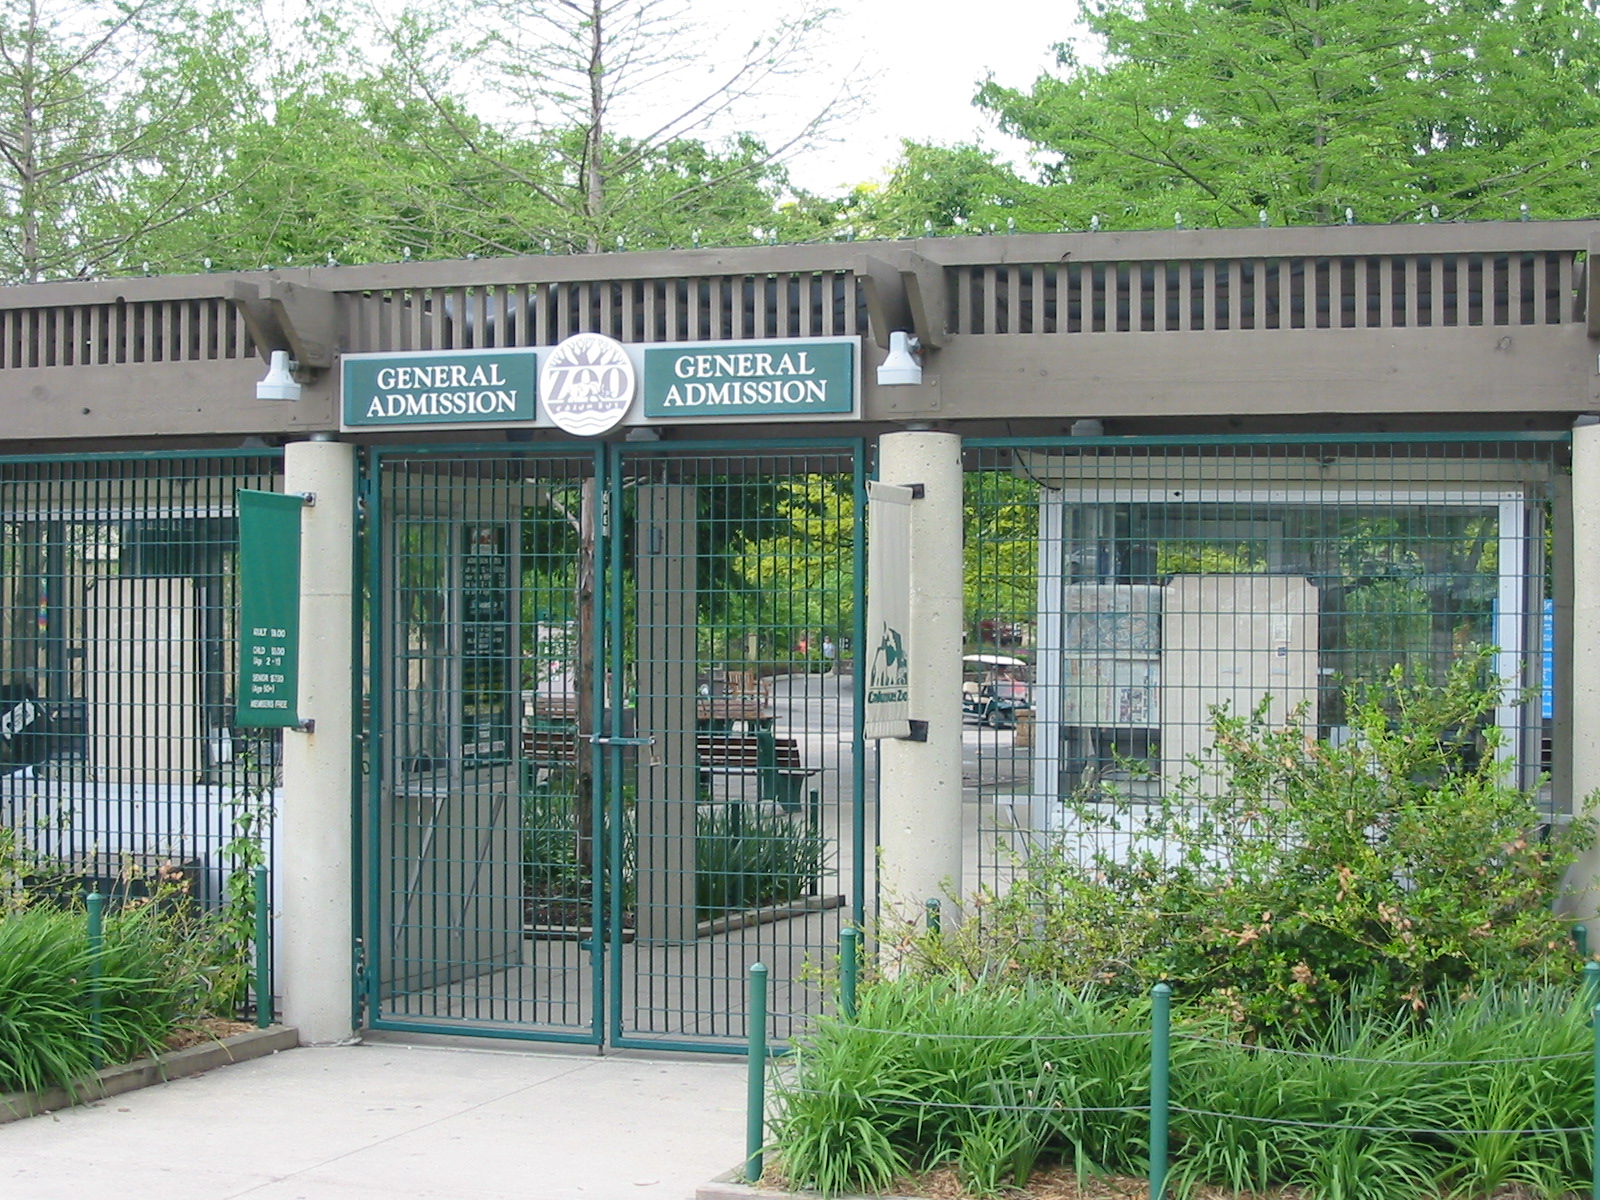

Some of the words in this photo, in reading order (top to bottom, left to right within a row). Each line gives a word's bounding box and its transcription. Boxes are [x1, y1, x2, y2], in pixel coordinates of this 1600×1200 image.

[377, 363, 506, 390] GENERAL
[674, 352, 816, 378] GENERAL
[547, 366, 629, 402] ZOO
[663, 380, 828, 407] ADMISSION
[366, 390, 518, 418] ADMISSION
